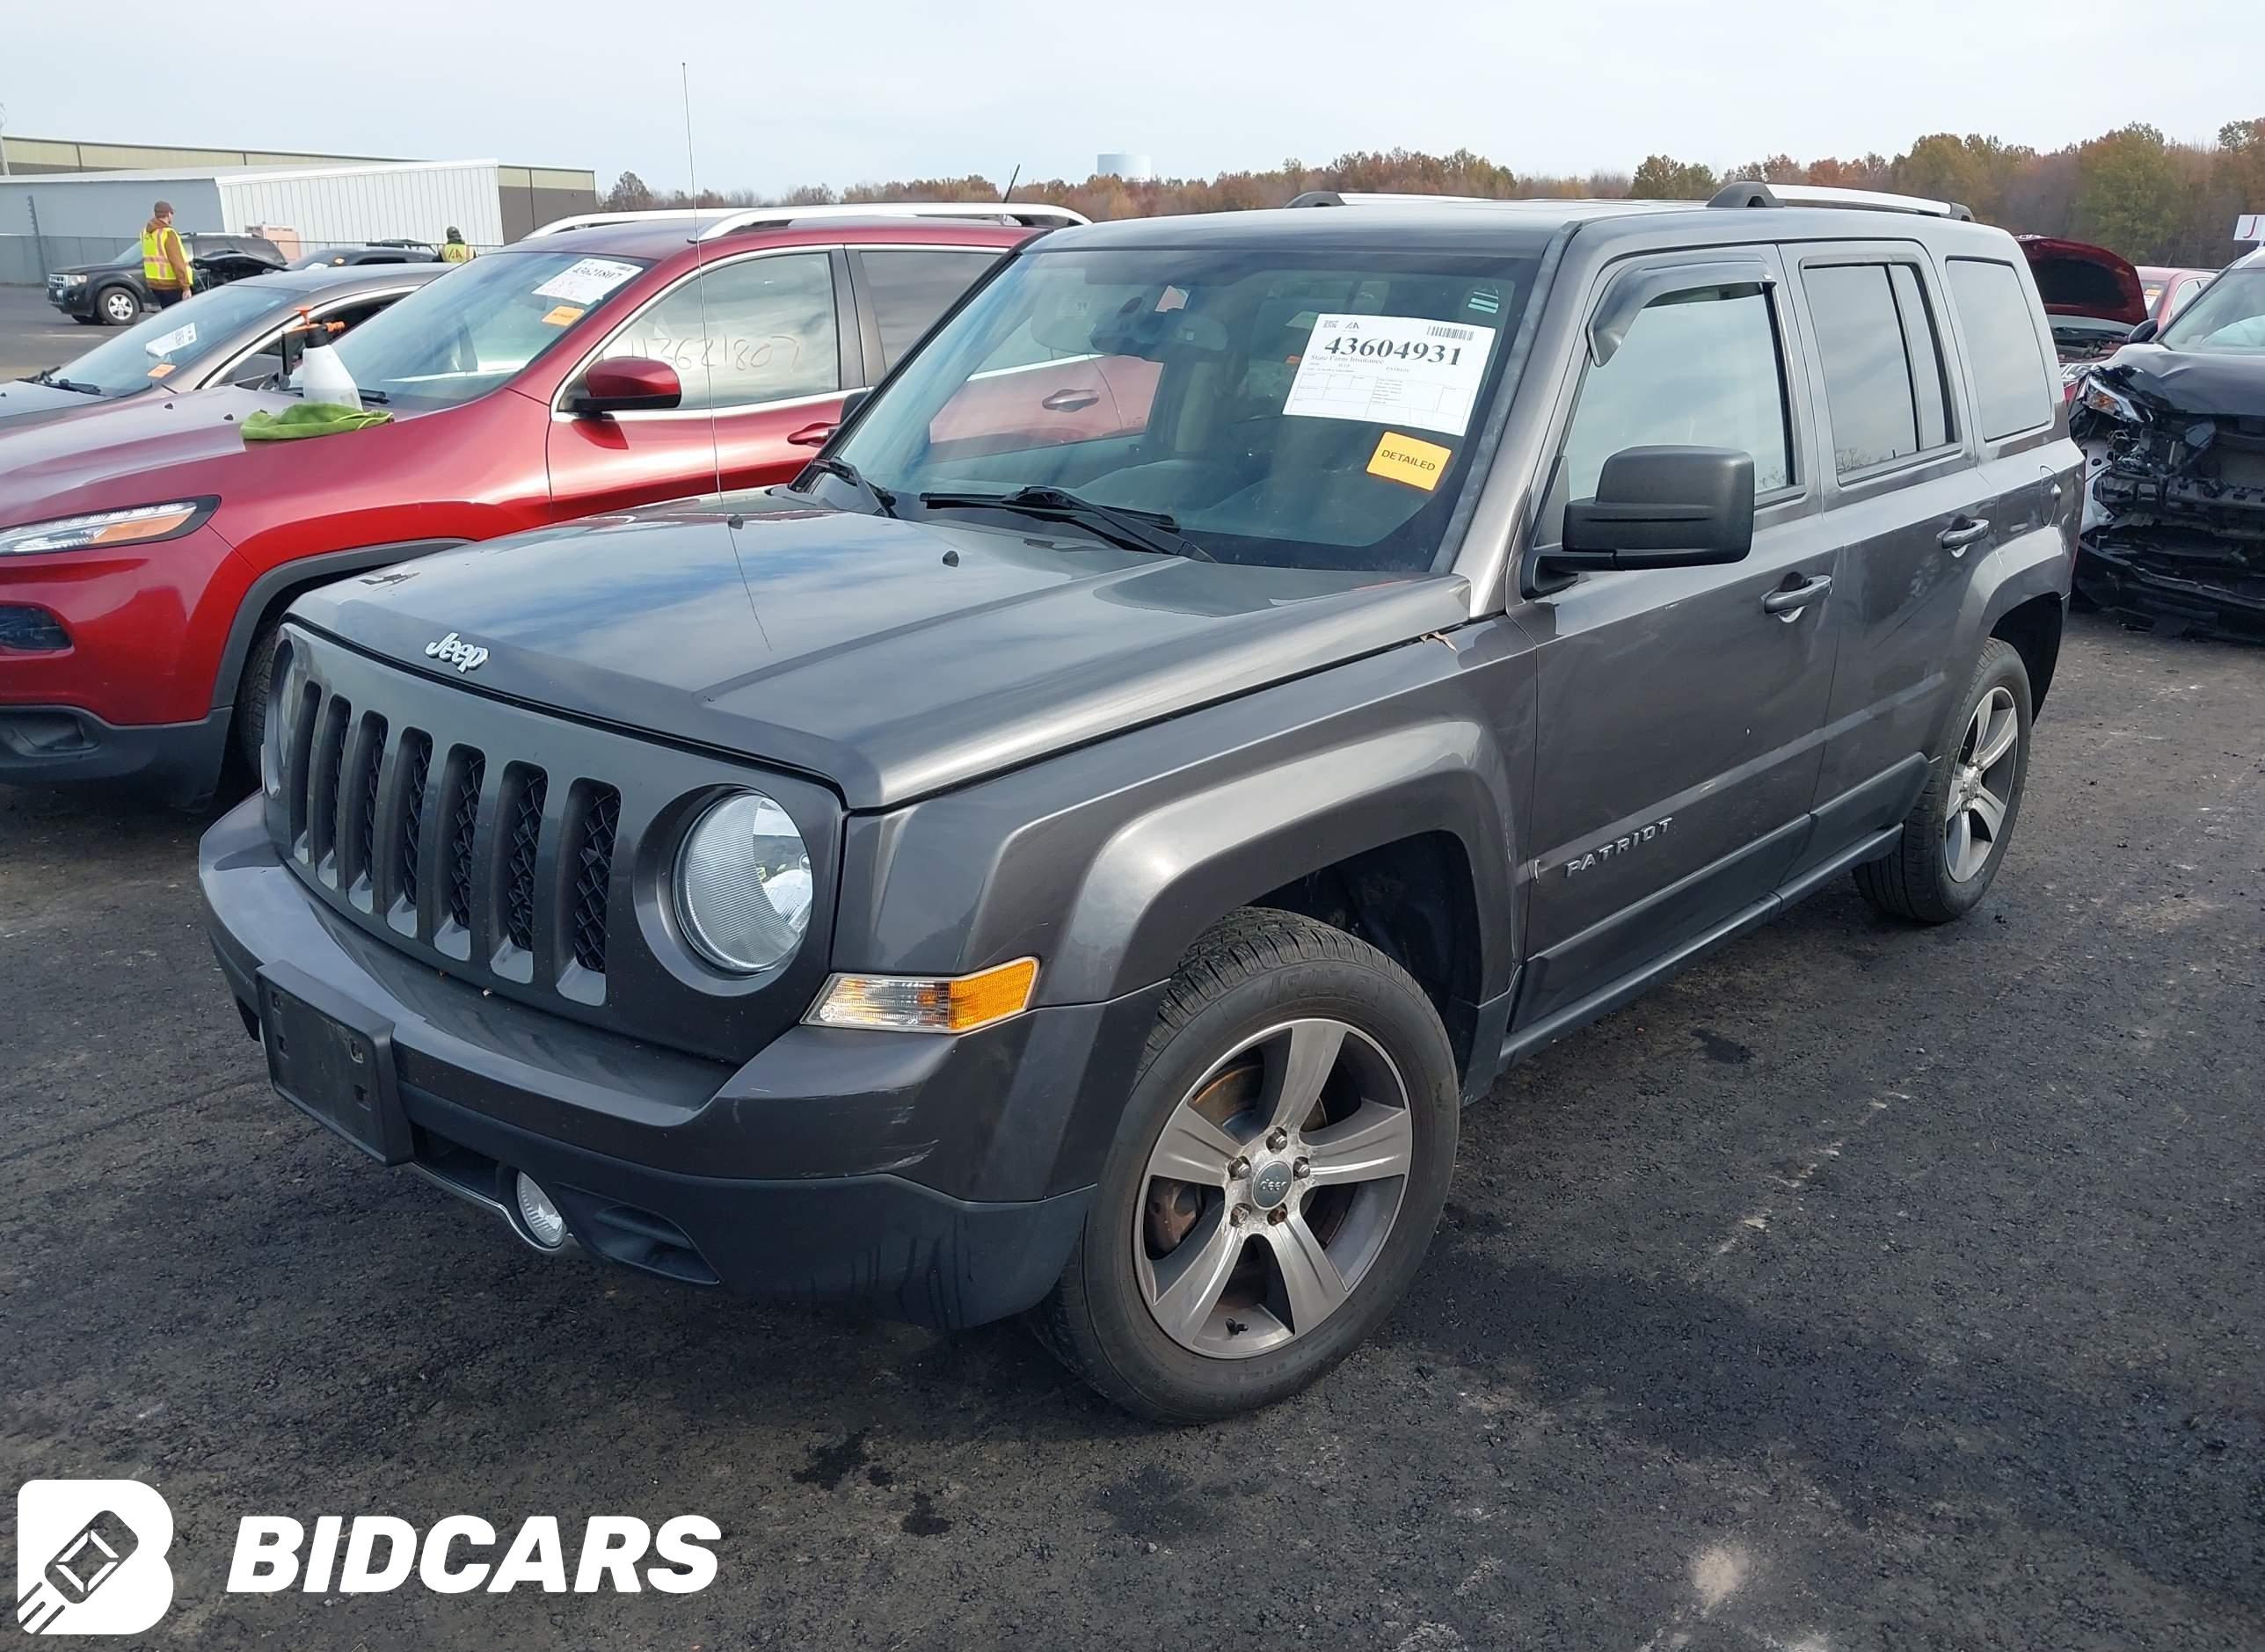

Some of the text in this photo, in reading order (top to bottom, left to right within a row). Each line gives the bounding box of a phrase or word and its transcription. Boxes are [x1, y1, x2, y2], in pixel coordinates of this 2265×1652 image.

[1324, 336, 1461, 366] 43604931
[1380, 448, 1436, 471] DETAILED
[426, 632, 489, 673] Jeep
[1565, 817, 1673, 878] PATRIOT
